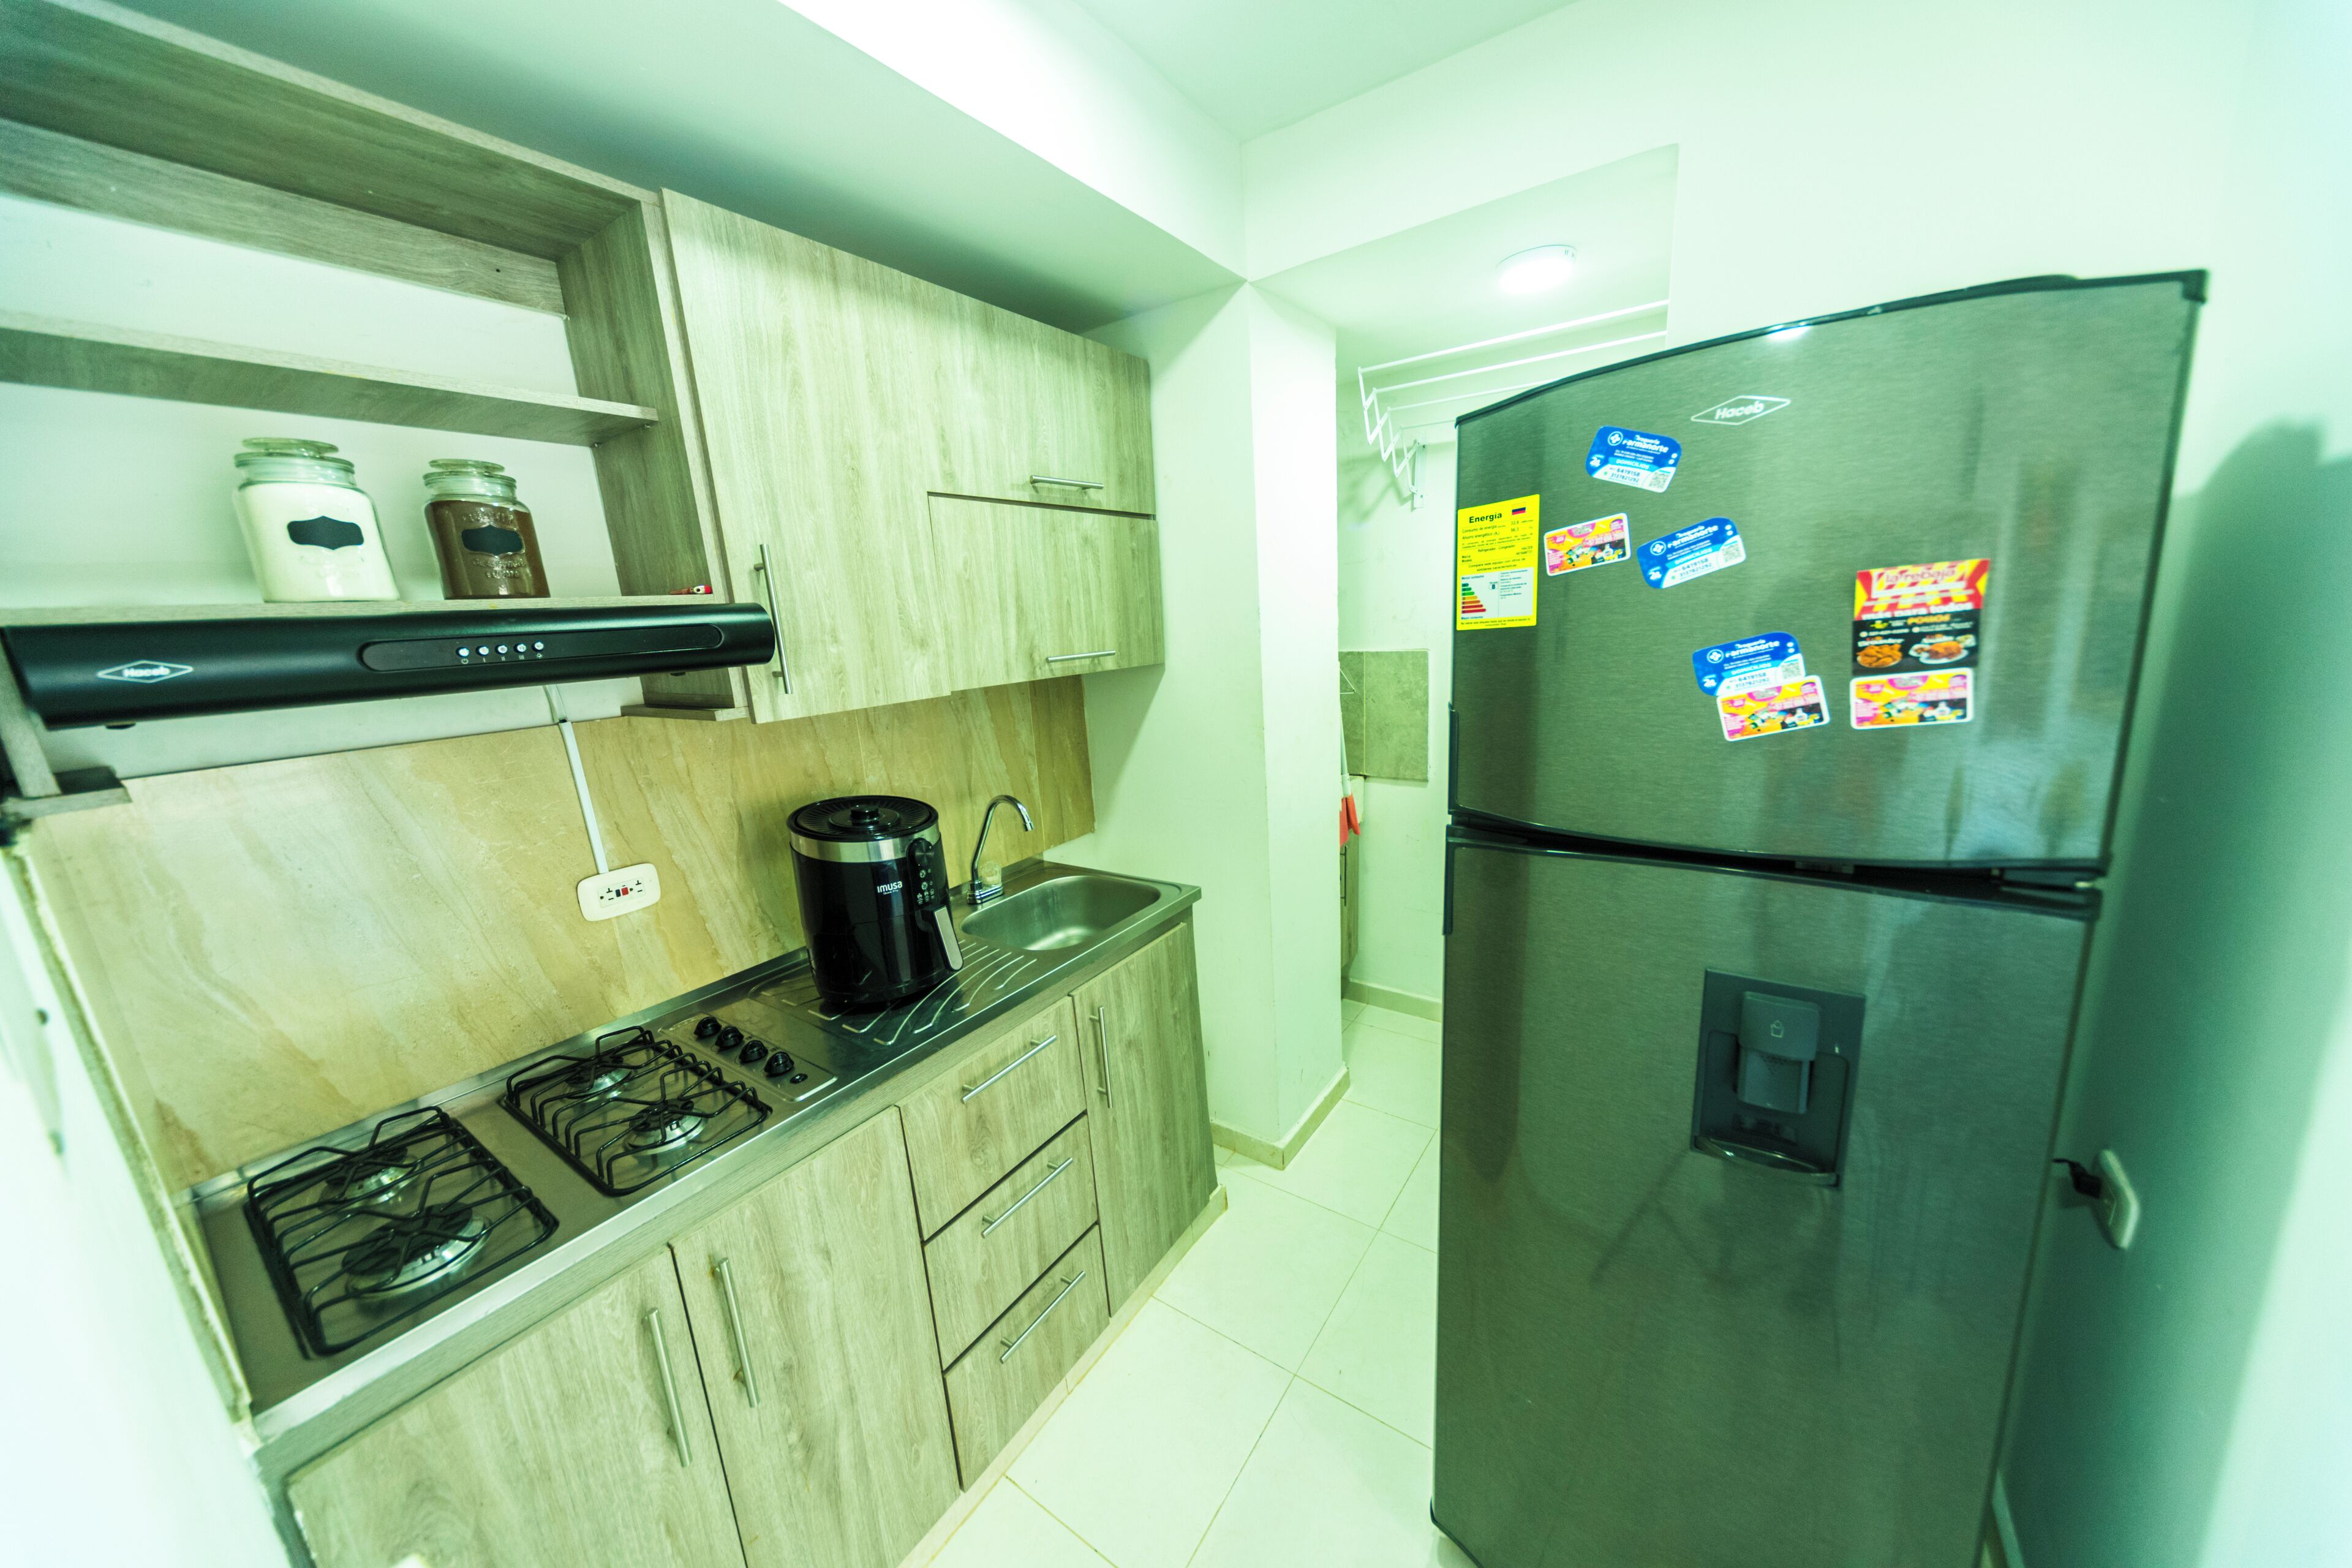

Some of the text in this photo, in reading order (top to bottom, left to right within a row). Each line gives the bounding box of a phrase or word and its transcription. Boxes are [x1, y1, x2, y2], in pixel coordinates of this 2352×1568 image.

[1714, 400, 1765, 420] Haceb
[1616, 459, 1650, 469] DOMICILIOS
[1617, 467, 1640, 477] 6419158
